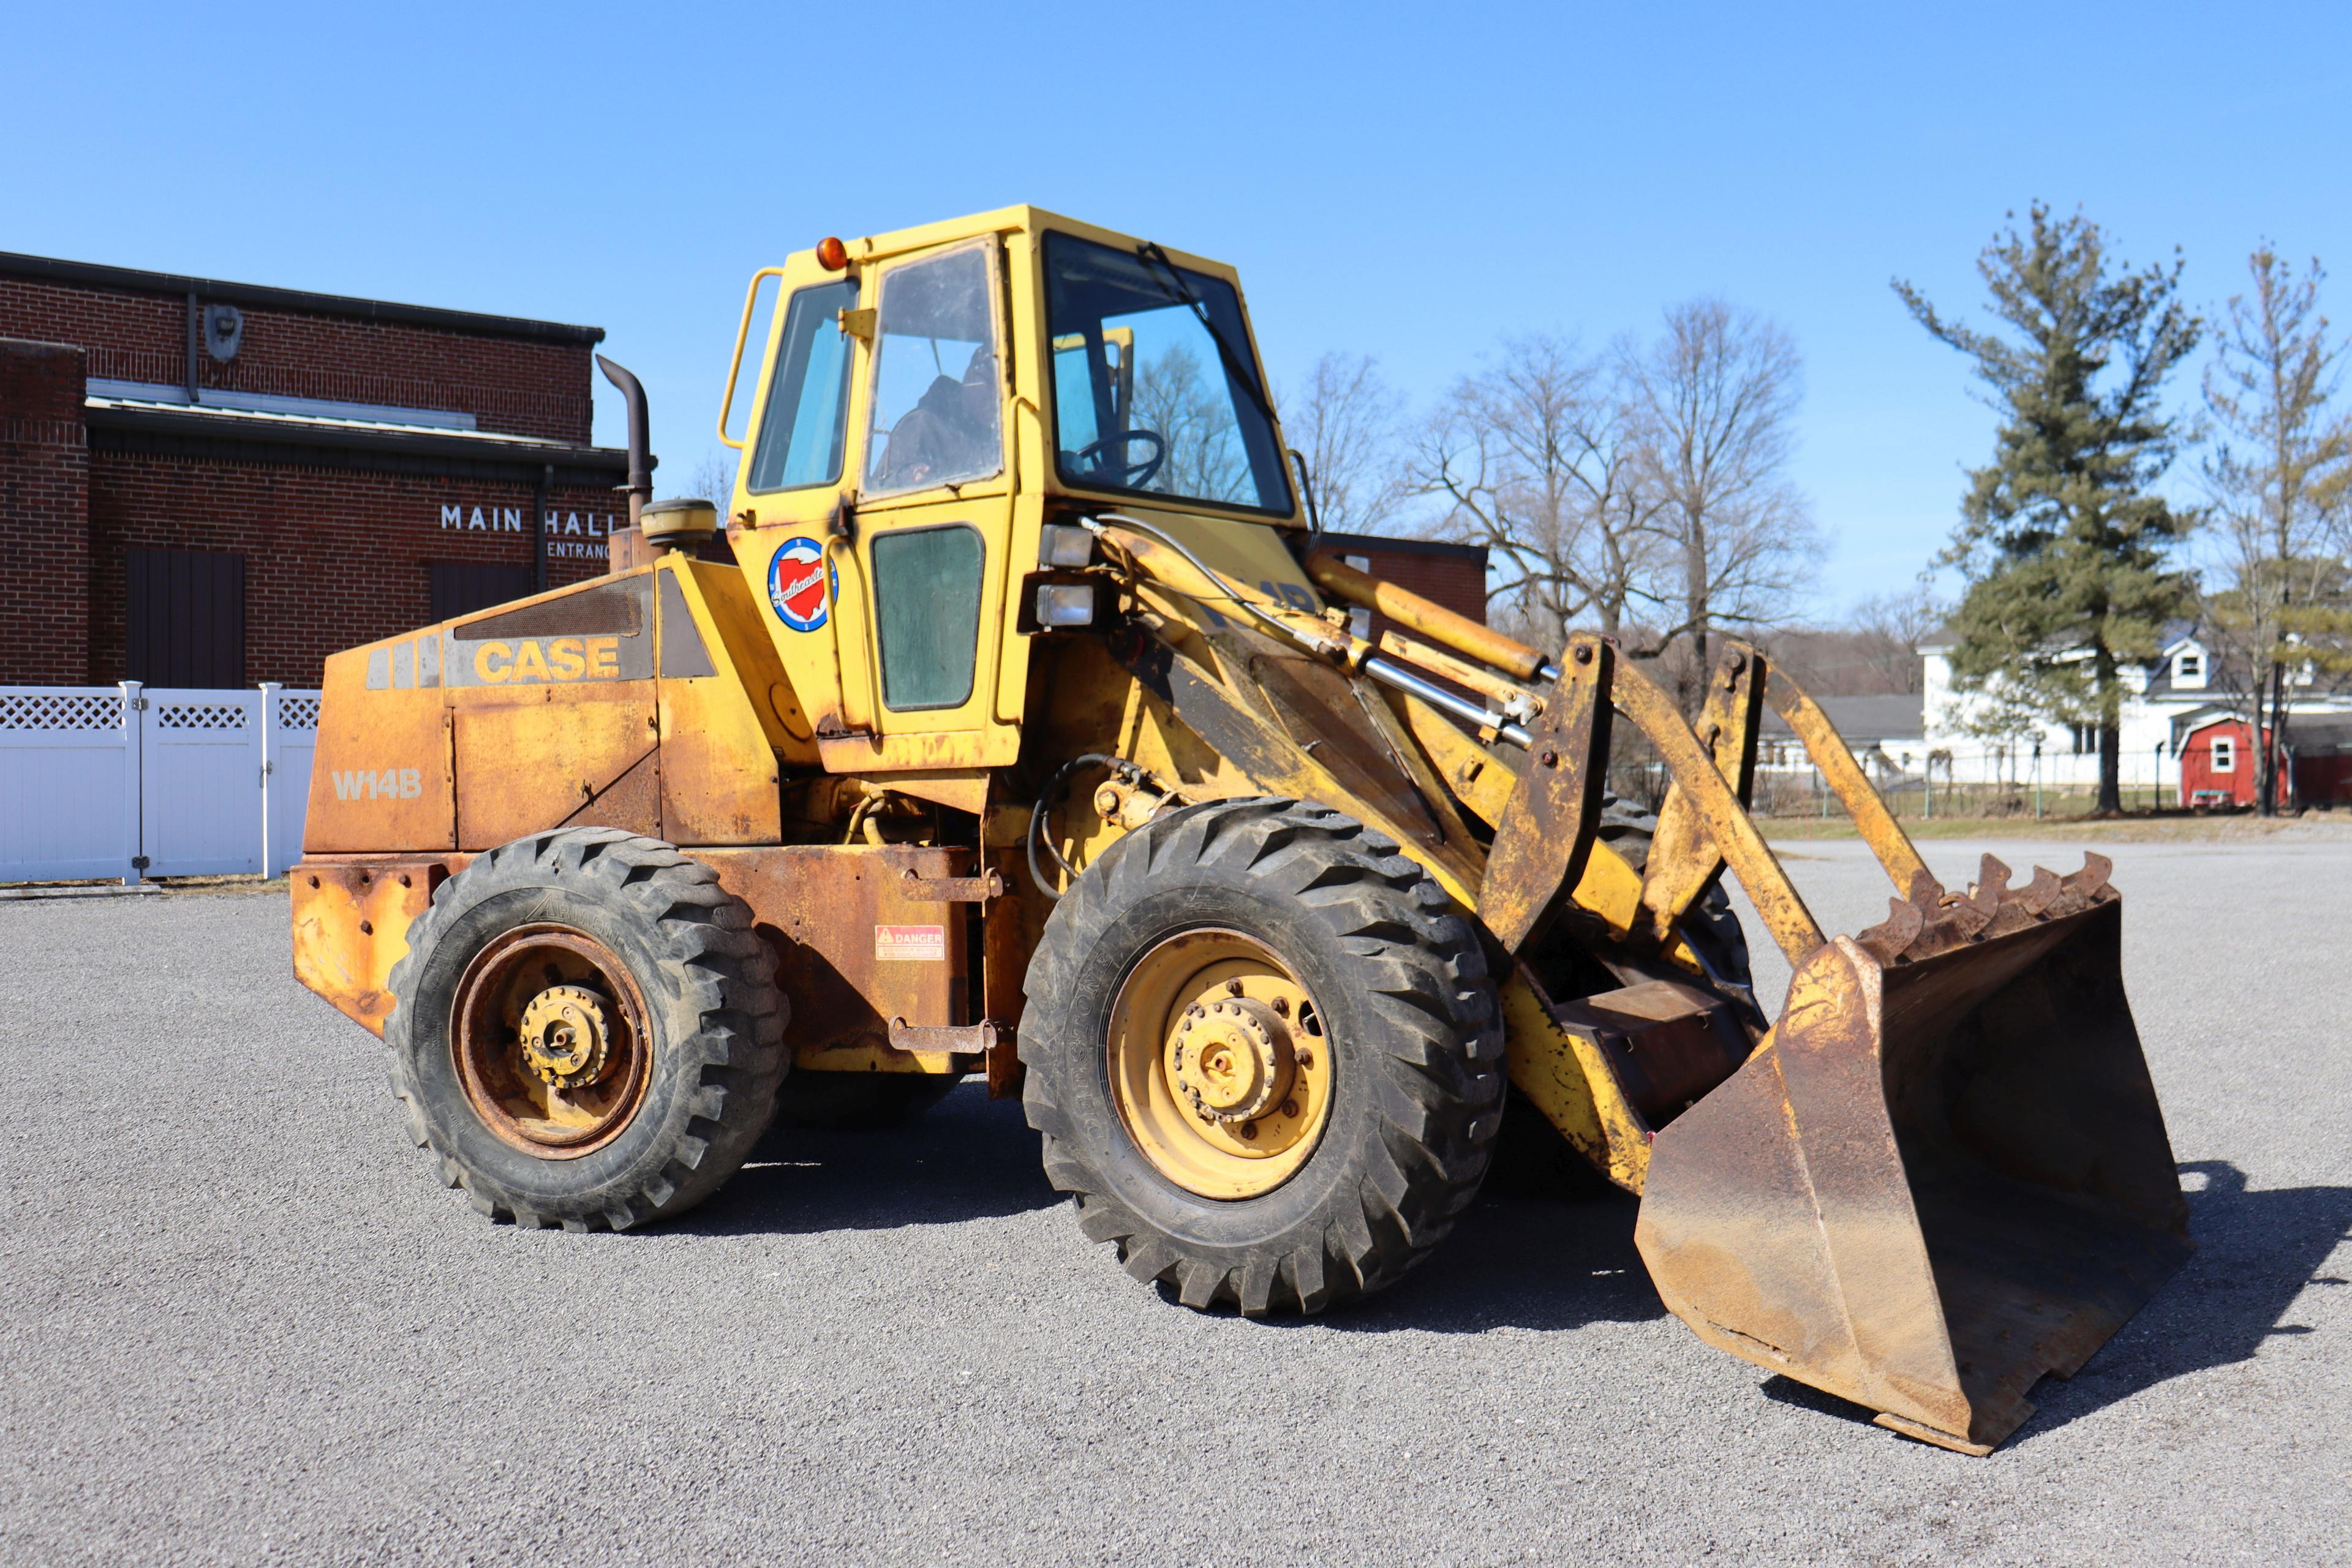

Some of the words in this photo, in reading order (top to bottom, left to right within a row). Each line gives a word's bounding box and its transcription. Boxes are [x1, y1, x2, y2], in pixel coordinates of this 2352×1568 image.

[441, 505, 522, 532] MAIN
[545, 510, 614, 537] HALL
[473, 636, 620, 684] CASE
[331, 767, 423, 801] W14B
[895, 933, 942, 943] DANGER
[1069, 949, 1114, 1144] DEESTONE
